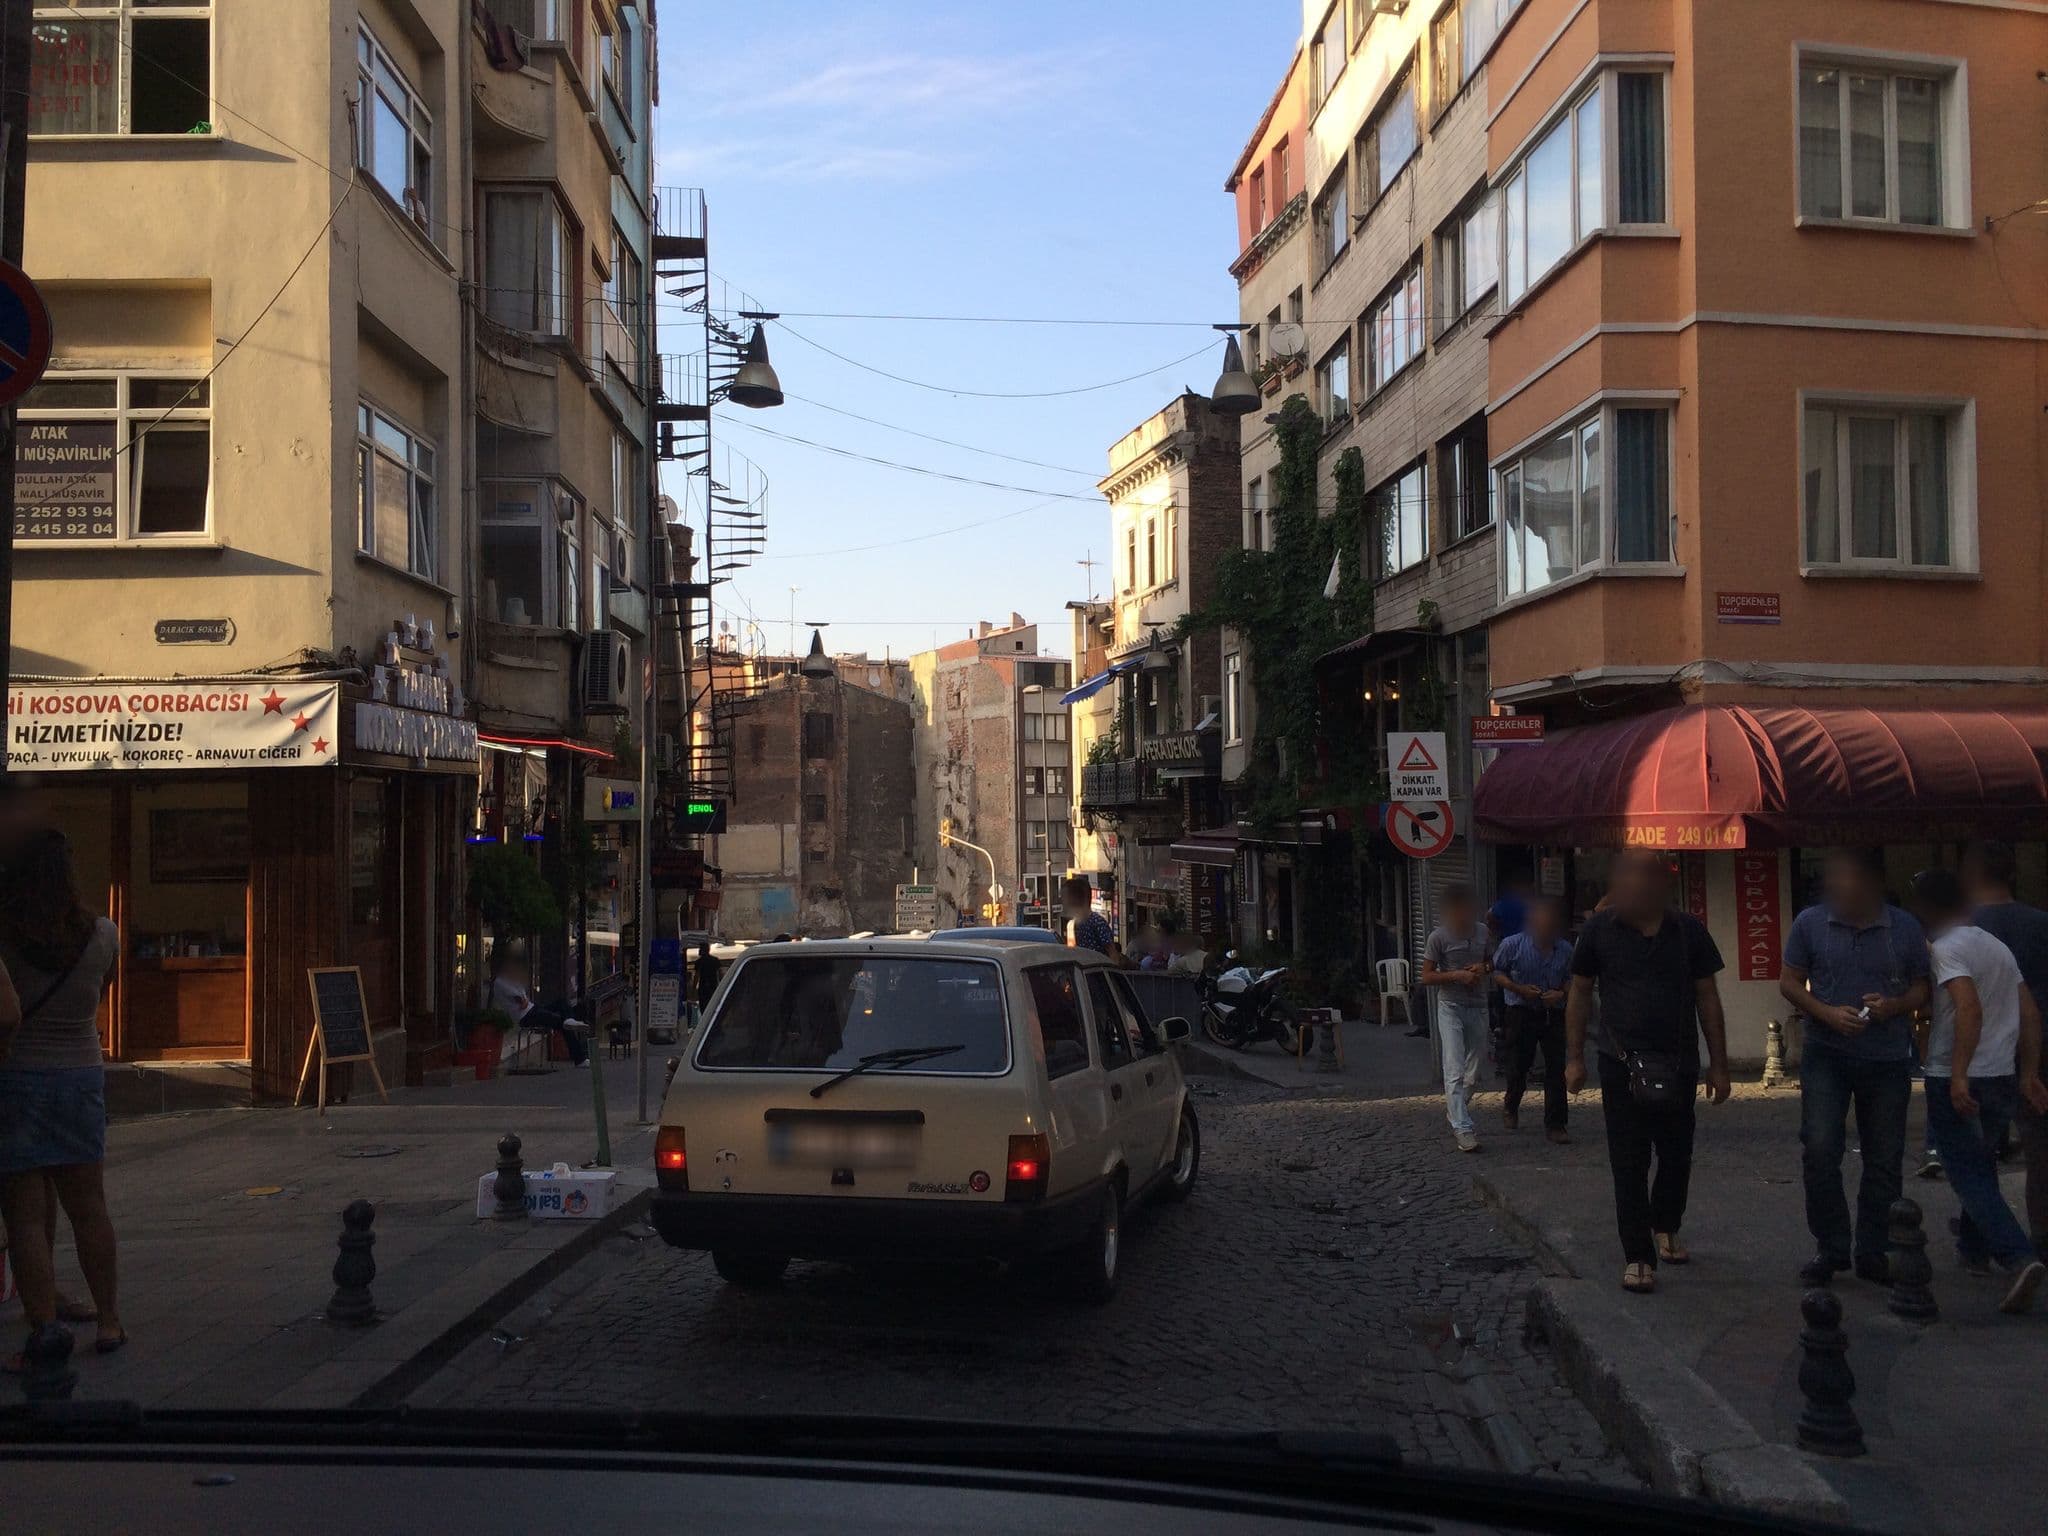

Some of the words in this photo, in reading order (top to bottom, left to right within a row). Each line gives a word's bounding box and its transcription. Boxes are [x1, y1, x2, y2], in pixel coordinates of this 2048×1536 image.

[30, 426, 68, 440] ATAK
[24, 444, 113, 465] MÜŞAVİRLİK
[66, 475, 97, 484] ATAK
[30, 506, 62, 518] 252
[66, 506, 88, 518] 93
[92, 506, 114, 518] 94
[30, 523, 62, 535] 415
[66, 523, 88, 535] 92
[92, 523, 114, 535] 04
[29, 694, 122, 715] KOSOVA
[127, 693, 250, 718] ÇORBACISI
[15, 719, 184, 744] HİZMETİNİZDE!
[1474, 719, 1541, 731] TOPÇEKENLER
[51, 750, 110, 763] UYKULUK
[122, 749, 184, 763] KOKOREÇ
[195, 748, 256, 761] ARNAVUT
[1396, 787, 1424, 796] KAPAN
[1425, 786, 1442, 796] VAR
[1676, 826, 1701, 846] 249
[1722, 826, 1740, 845] 47
